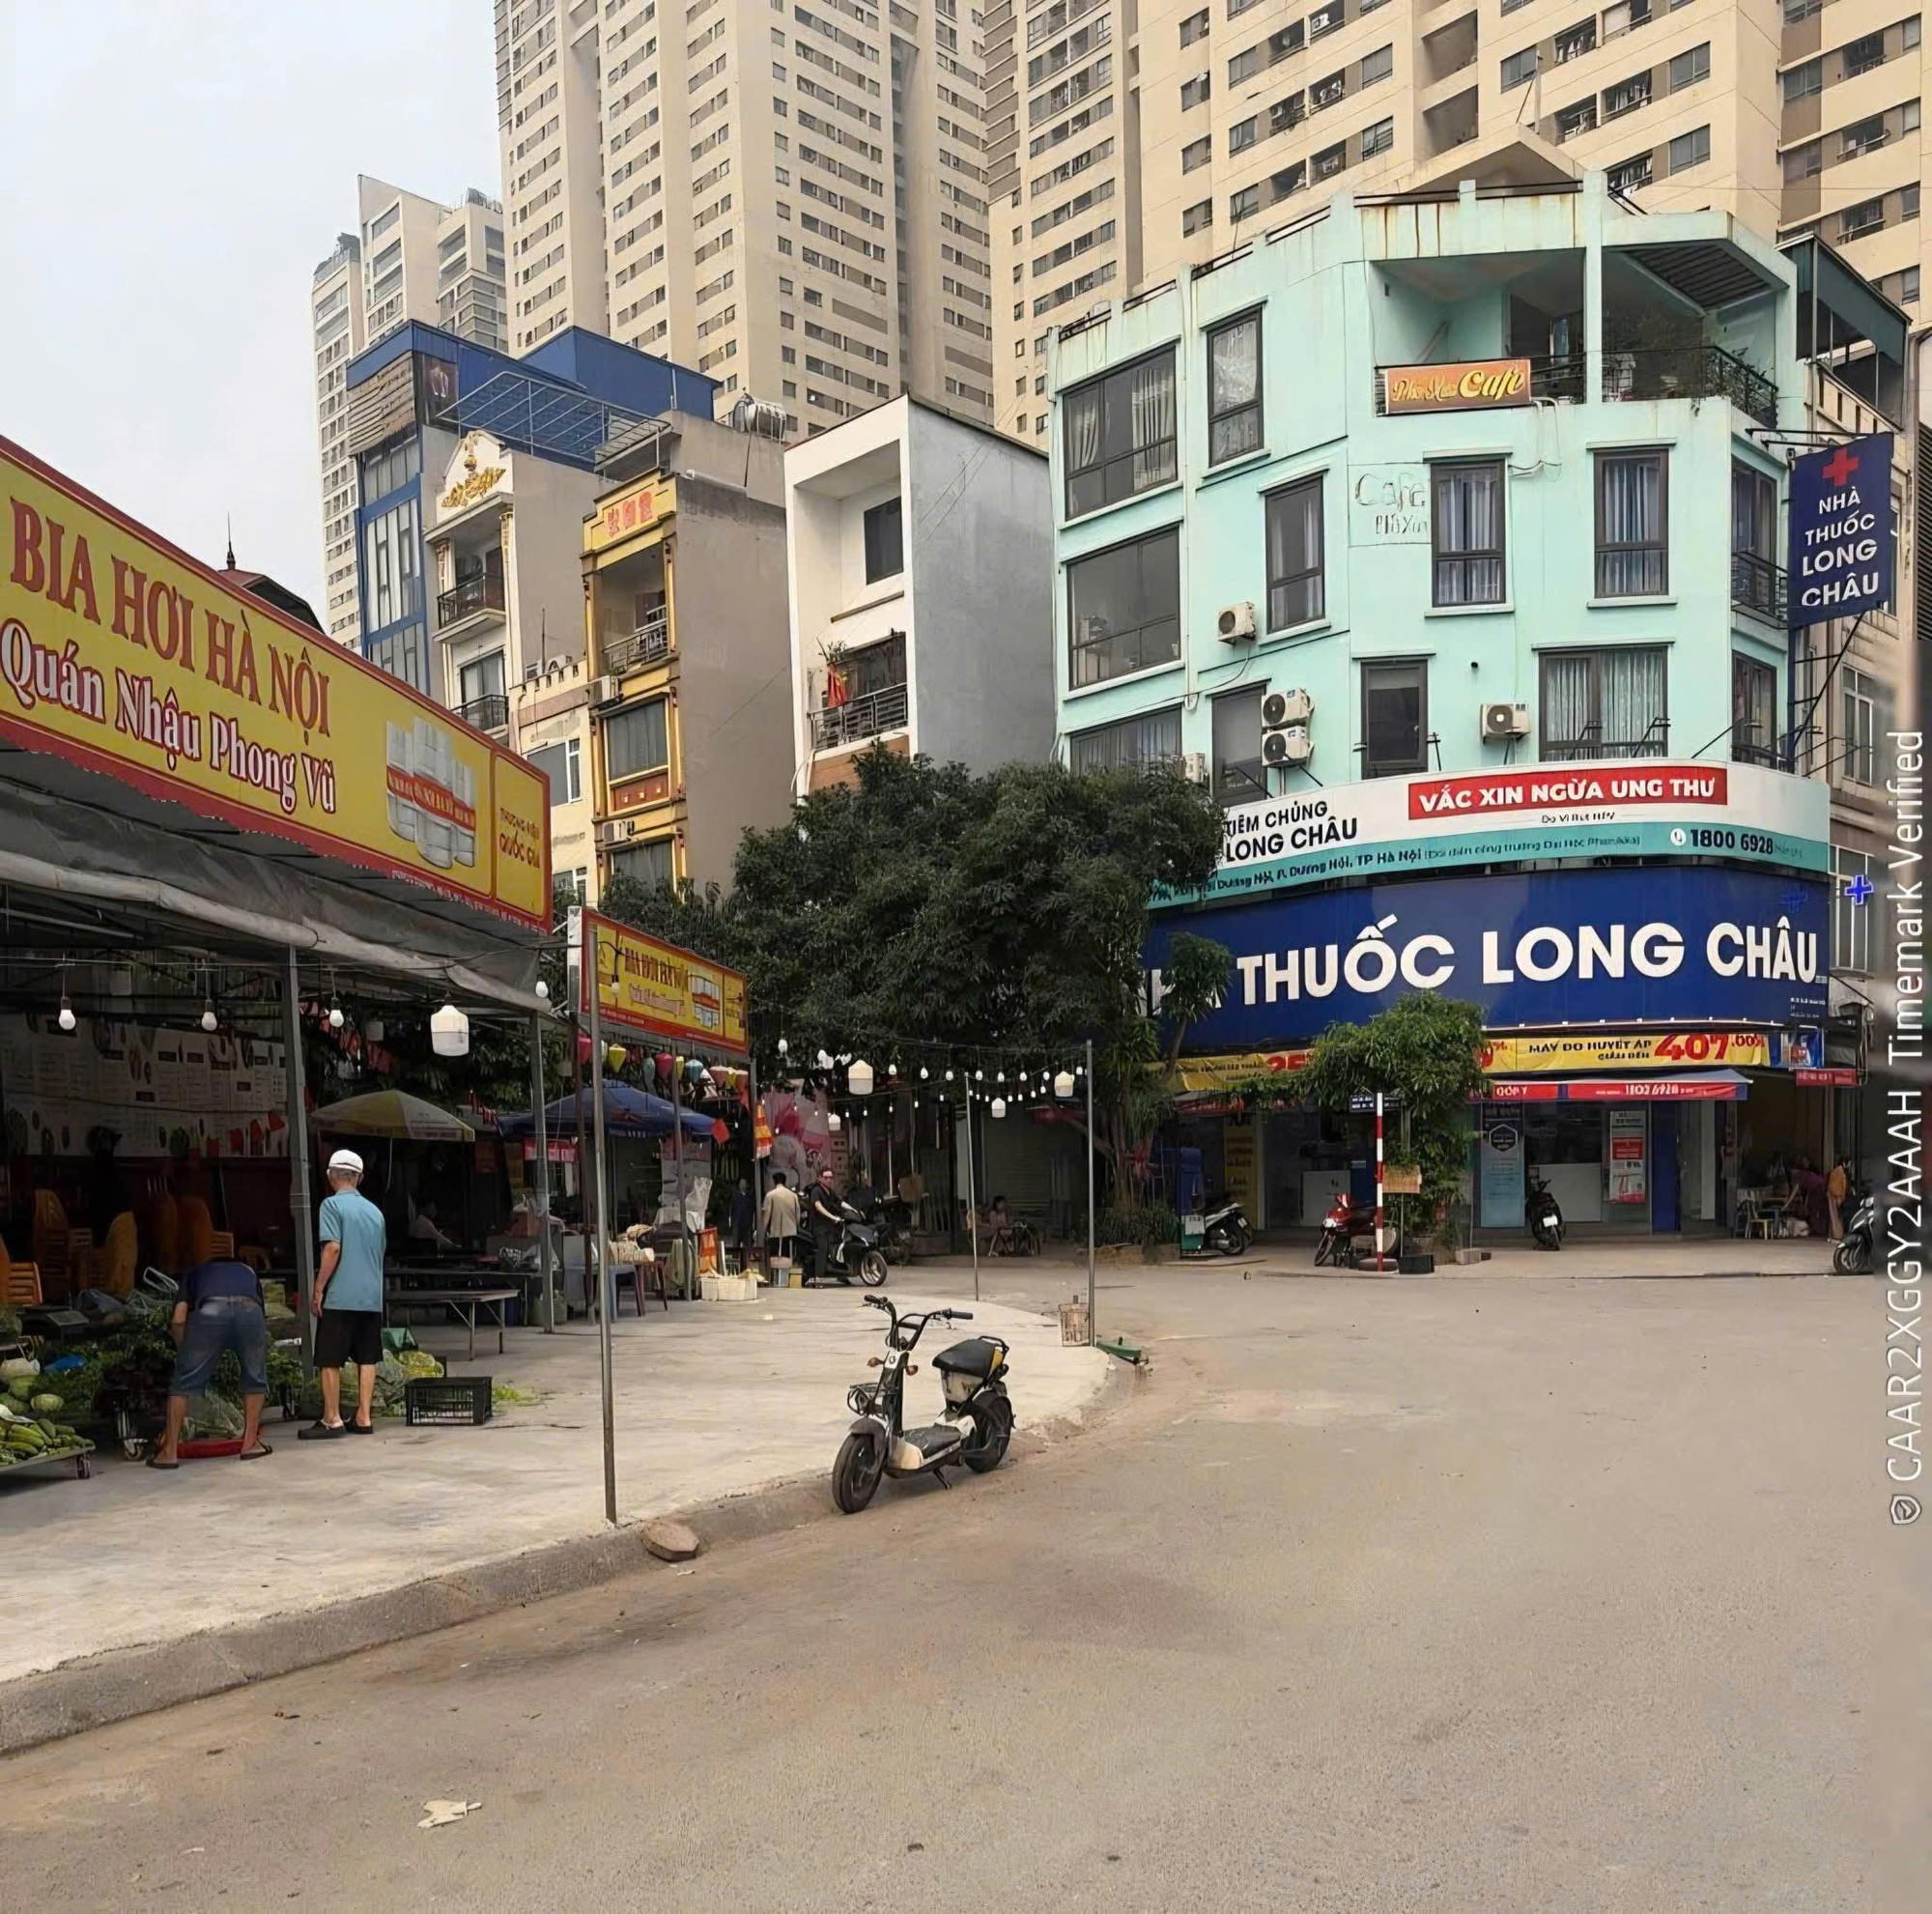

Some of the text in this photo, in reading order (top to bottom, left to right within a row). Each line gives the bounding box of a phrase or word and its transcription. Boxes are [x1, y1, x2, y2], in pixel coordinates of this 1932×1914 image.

[1819, 486, 1861, 514] NHÀ
[1803, 538, 1877, 577] LONG
[1802, 572, 1879, 607] CHÂU
[10, 495, 330, 746] BIA HƠI HÀ NỘI
[0, 617, 105, 725] Quán
[115, 667, 202, 771] Nhậu
[209, 711, 298, 815] Phong
[300, 752, 336, 814] Vũ
[1419, 778, 1717, 813] VẮC XIN NGỪA UNG THƯ
[1226, 815, 1358, 863] LONG CHÂU
[1690, 828, 1736, 849] 1800
[1740, 833, 1774, 855] 6928
[1356, 853, 1374, 866] TP
[1236, 913, 1456, 1006] THUỐC
[1482, 921, 1686, 985] LONG
[1706, 915, 1818, 985] CHÂU
